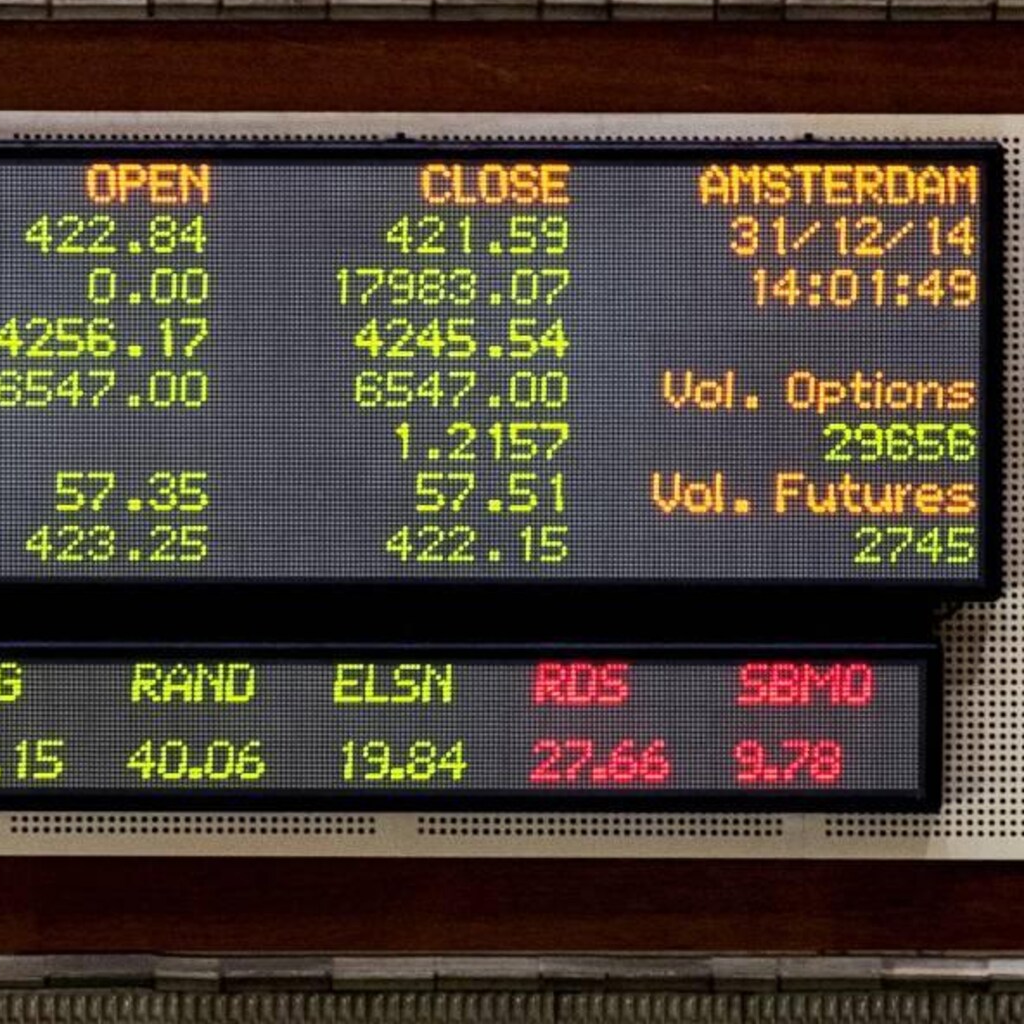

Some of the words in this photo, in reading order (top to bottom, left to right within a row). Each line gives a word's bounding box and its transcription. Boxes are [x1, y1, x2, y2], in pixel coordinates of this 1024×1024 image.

[85, 164, 210, 205] OPEN
[420, 164, 570, 205] CLOSE
[698, 165, 978, 206] AMSTERDAM
[27, 216, 204, 253] 422.84
[387, 216, 567, 253] 421.59
[732, 215, 974, 256] 31/12/14
[88, 268, 208, 304] 0.00
[338, 269, 570, 304] 17983.07
[754, 269, 977, 306] 14:01:49
[354, 318, 569, 358] 4245.54
[355, 371, 568, 407] 6547.00
[663, 371, 759, 409] Vol.
[785, 371, 976, 413] Options
[396, 422, 569, 459] 1.2157
[824, 424, 976, 460] 29656
[57, 472, 208, 511] 57.35
[416, 472, 563, 512] 57.51
[651, 472, 751, 514] Vol.
[775, 472, 976, 514] Futures
[27, 526, 206, 560] 423.25
[387, 526, 567, 561] 422.15
[856, 527, 971, 562] 2745
[132, 664, 254, 702] RAND
[334, 664, 452, 703] ELSN
[532, 664, 629, 706] RDS
[737, 664, 875, 706] SBMO
[128, 741, 265, 779] 40.06
[344, 741, 466, 780] 19.84
[530, 739, 670, 783] 27.66
[733, 739, 841, 783] 9.78
